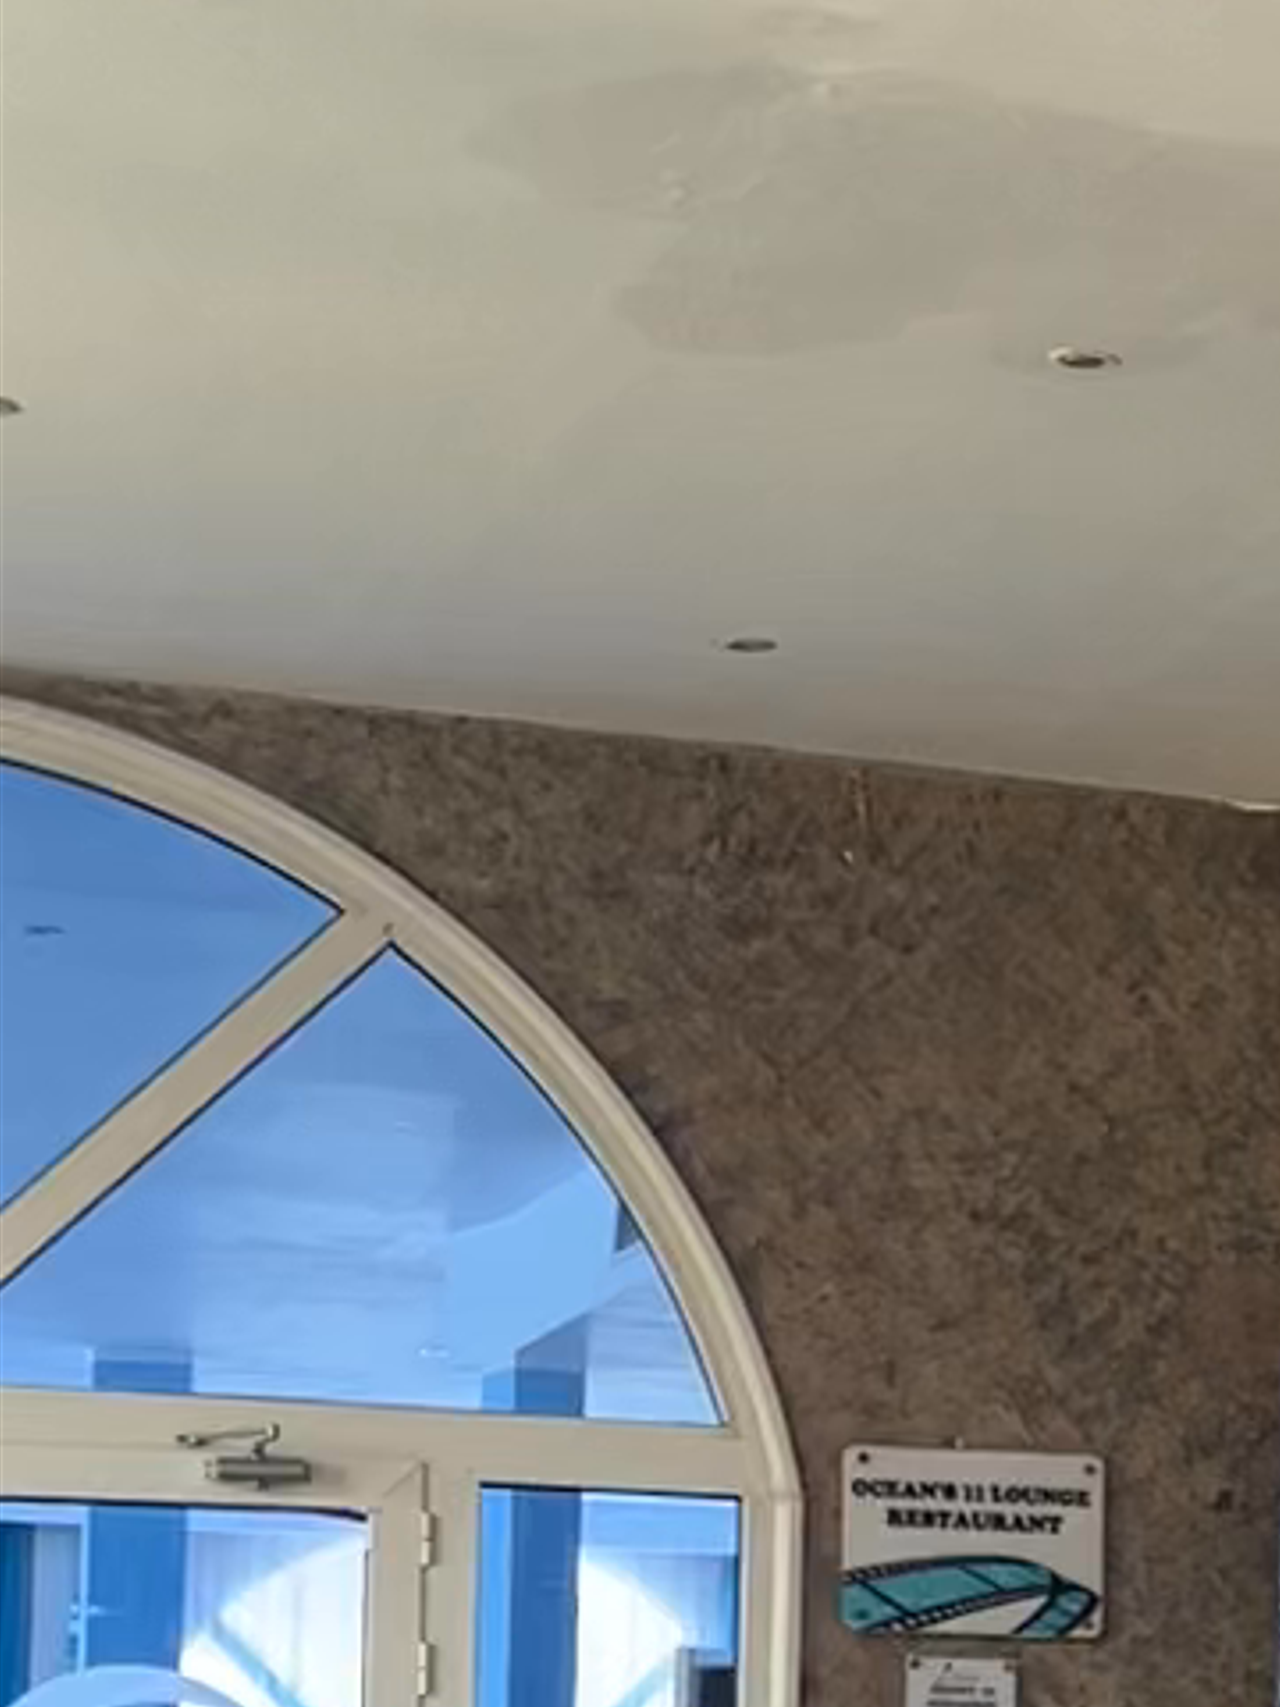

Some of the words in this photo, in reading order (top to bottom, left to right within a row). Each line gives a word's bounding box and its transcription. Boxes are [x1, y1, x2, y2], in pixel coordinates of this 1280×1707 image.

[851, 1478, 957, 1501] OCEAN'S
[963, 1483, 986, 1504] 11
[991, 1483, 1092, 1508] LOUNGE
[887, 1507, 1064, 1535] RESTAURANT
